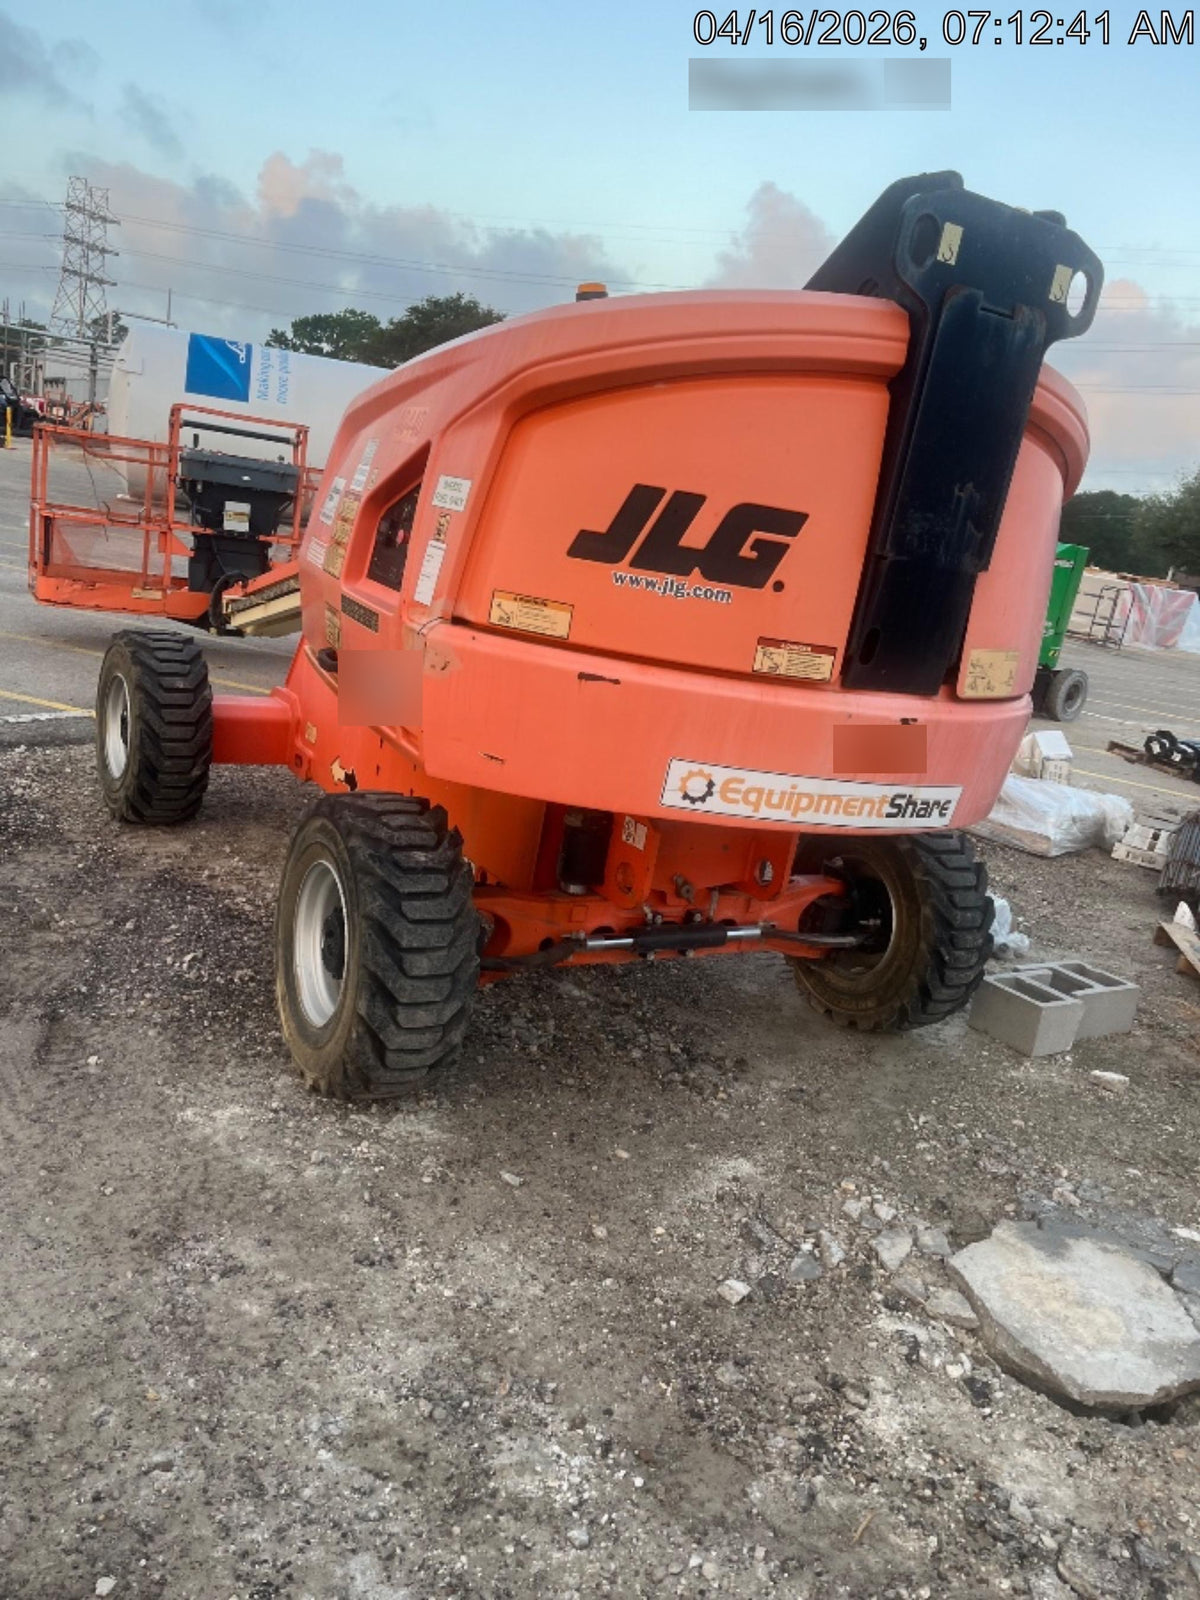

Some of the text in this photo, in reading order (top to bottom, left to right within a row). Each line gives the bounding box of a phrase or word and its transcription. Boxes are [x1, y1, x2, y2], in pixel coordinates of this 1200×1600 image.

[566, 483, 810, 590] JLG
[611, 570, 733, 604] www.jlg.com
[719, 777, 951, 820] EquipmentShare
